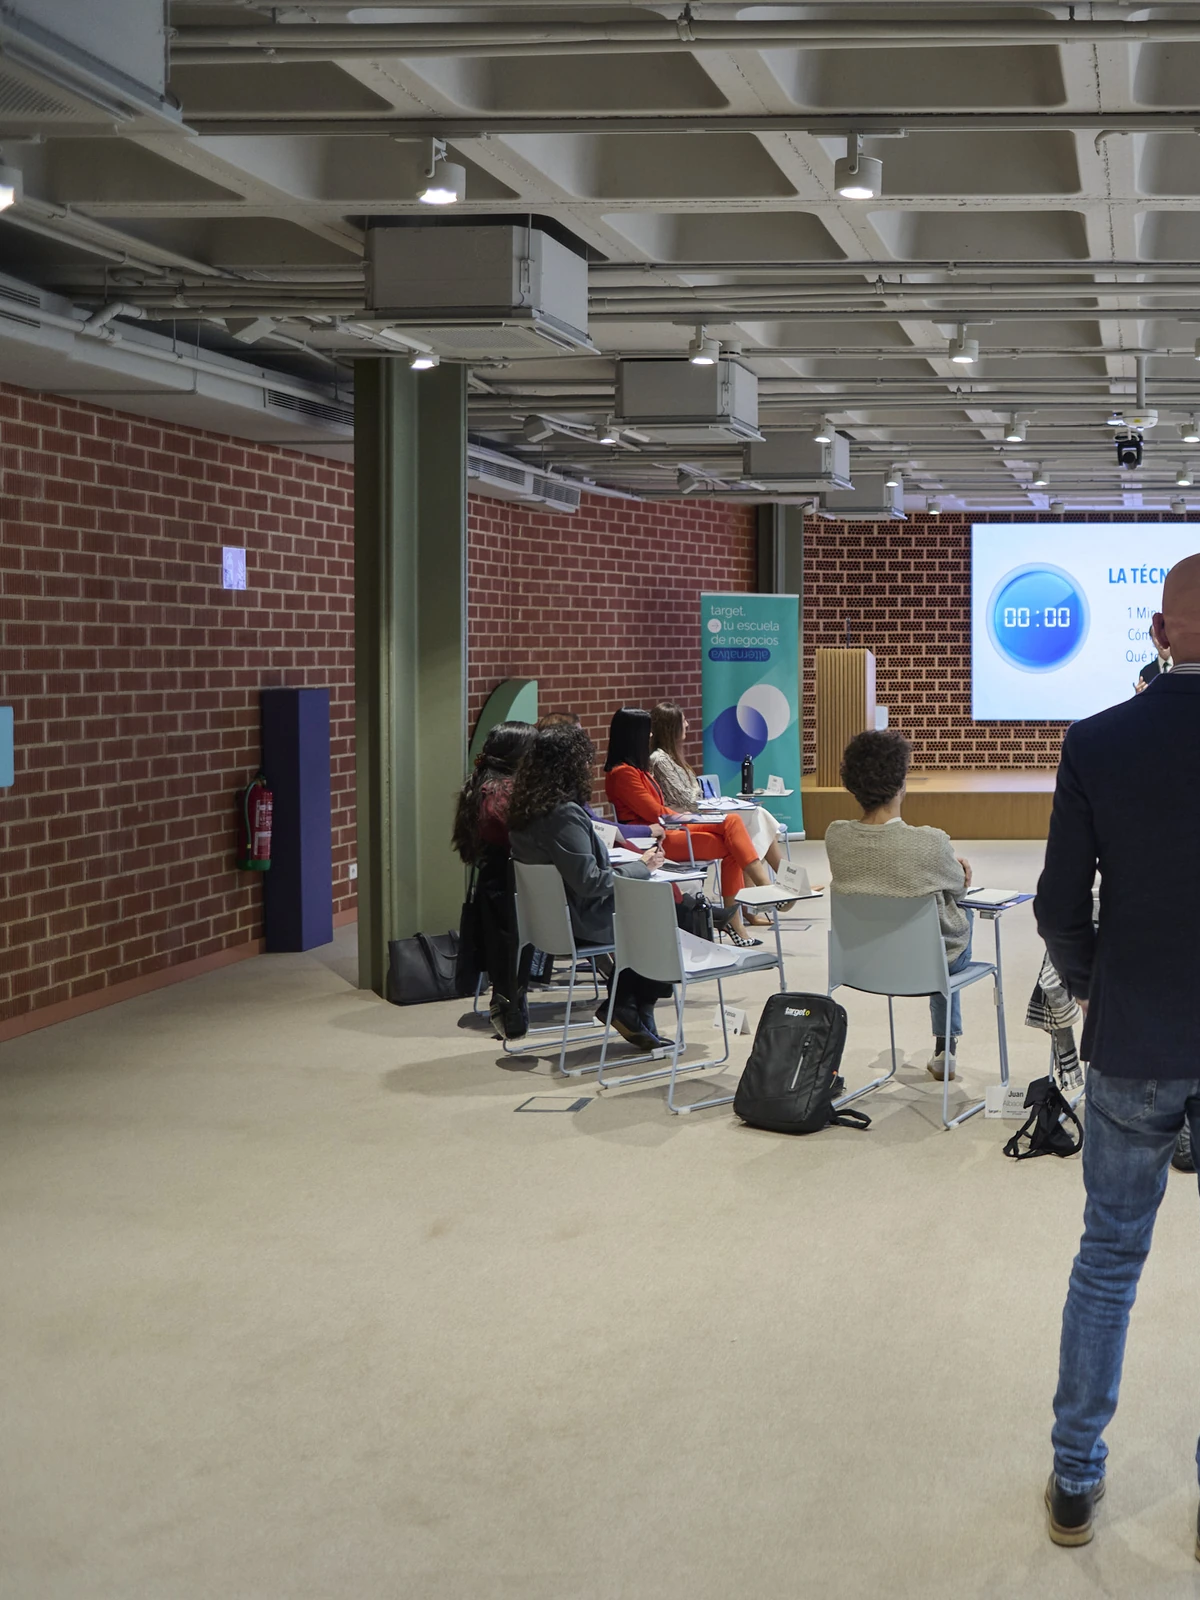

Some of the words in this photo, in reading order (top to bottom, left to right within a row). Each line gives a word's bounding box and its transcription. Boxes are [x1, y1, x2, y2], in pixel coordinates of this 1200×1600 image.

[1109, 568, 1127, 584] LA
[1131, 564, 1170, 584] TÉCN
[1004, 608, 1070, 627] 00:00
[1127, 607, 1132, 619] 1
[1137, 607, 1160, 619] Min
[723, 620, 734, 631] tu
[737, 621, 780, 631] escuela
[1128, 628, 1152, 641] Cóm
[711, 634, 725, 645] de
[729, 635, 779, 648] negocios
[711, 650, 769, 660] alternativa
[1126, 650, 1147, 662] Qué
